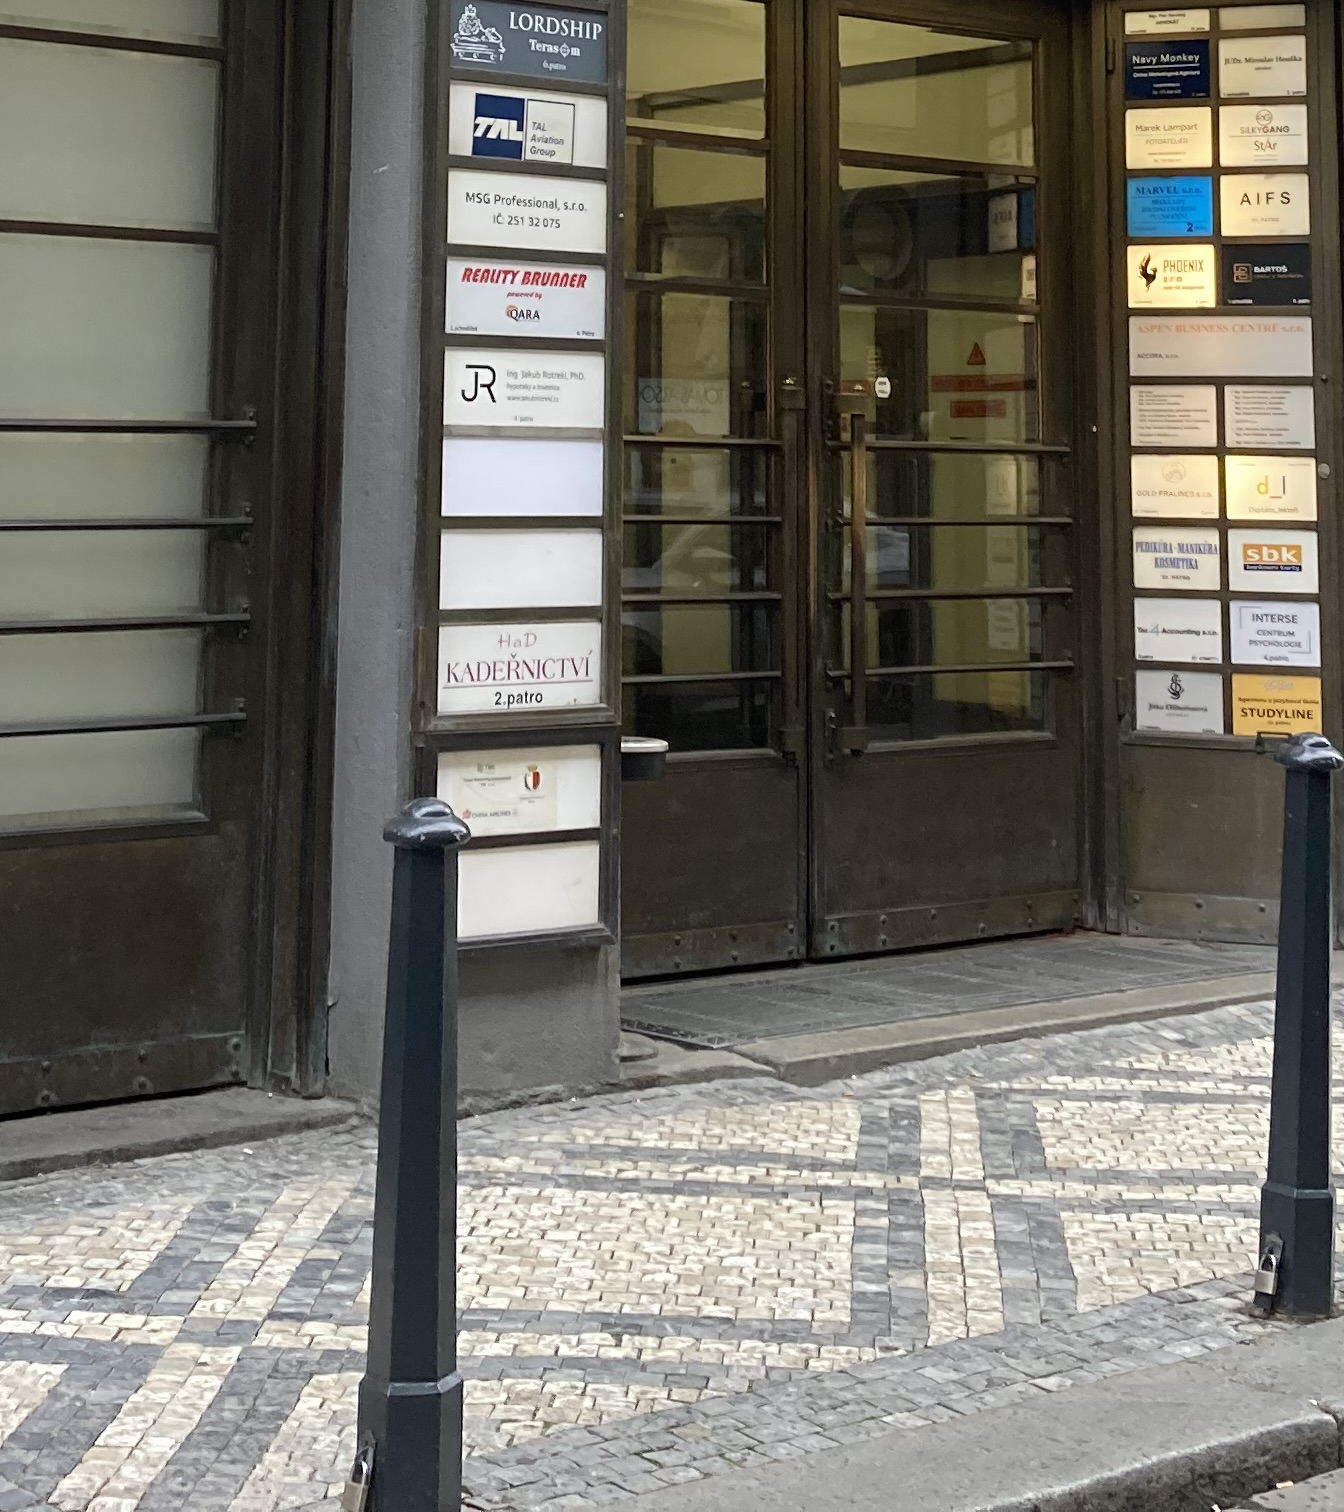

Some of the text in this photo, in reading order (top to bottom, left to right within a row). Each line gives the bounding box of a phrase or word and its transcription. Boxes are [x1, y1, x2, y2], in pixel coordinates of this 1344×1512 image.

[509, 11, 602, 40] LORDSHIP
[1132, 53, 1200, 66] Navy Monkey
[473, 116, 524, 141] TAL
[532, 121, 547, 132] TAL
[1136, 123, 1198, 133] Marek Lampart
[1240, 125, 1290, 134] SILKYGANG
[530, 134, 565, 146] Aviation
[530, 146, 556, 158] Group
[1136, 186, 1179, 194] MARVEL
[465, 191, 587, 212] MSG Professional, s.r.o.
[507, 215, 525, 226] 251
[528, 216, 540, 227] 32
[543, 218, 561, 229] 075
[1187, 222, 1193, 232] 2
[1163, 259, 1204, 273] PHOENIX
[1254, 265, 1288, 273] BARTOŠ
[461, 267, 588, 288] REALITY BRUNNER
[511, 309, 541, 322] QARA
[1137, 324, 1172, 333] ASPEN
[1175, 324, 1229, 333] BUSINESS
[1232, 323, 1279, 333] CENTRE
[521, 370, 541, 380] Jakub
[1247, 546, 1297, 563] sbk
[1154, 557, 1199, 570] KOSMETIKA
[1252, 613, 1298, 624] INTERSE
[1162, 627, 1200, 636] Accounting
[1249, 640, 1302, 648] PSYCHOLOGIE
[447, 649, 593, 684] KADEŘNICTVÍ
[1241, 708, 1314, 720] STUDYLINE
[489, 810, 511, 818] AIRLINES
